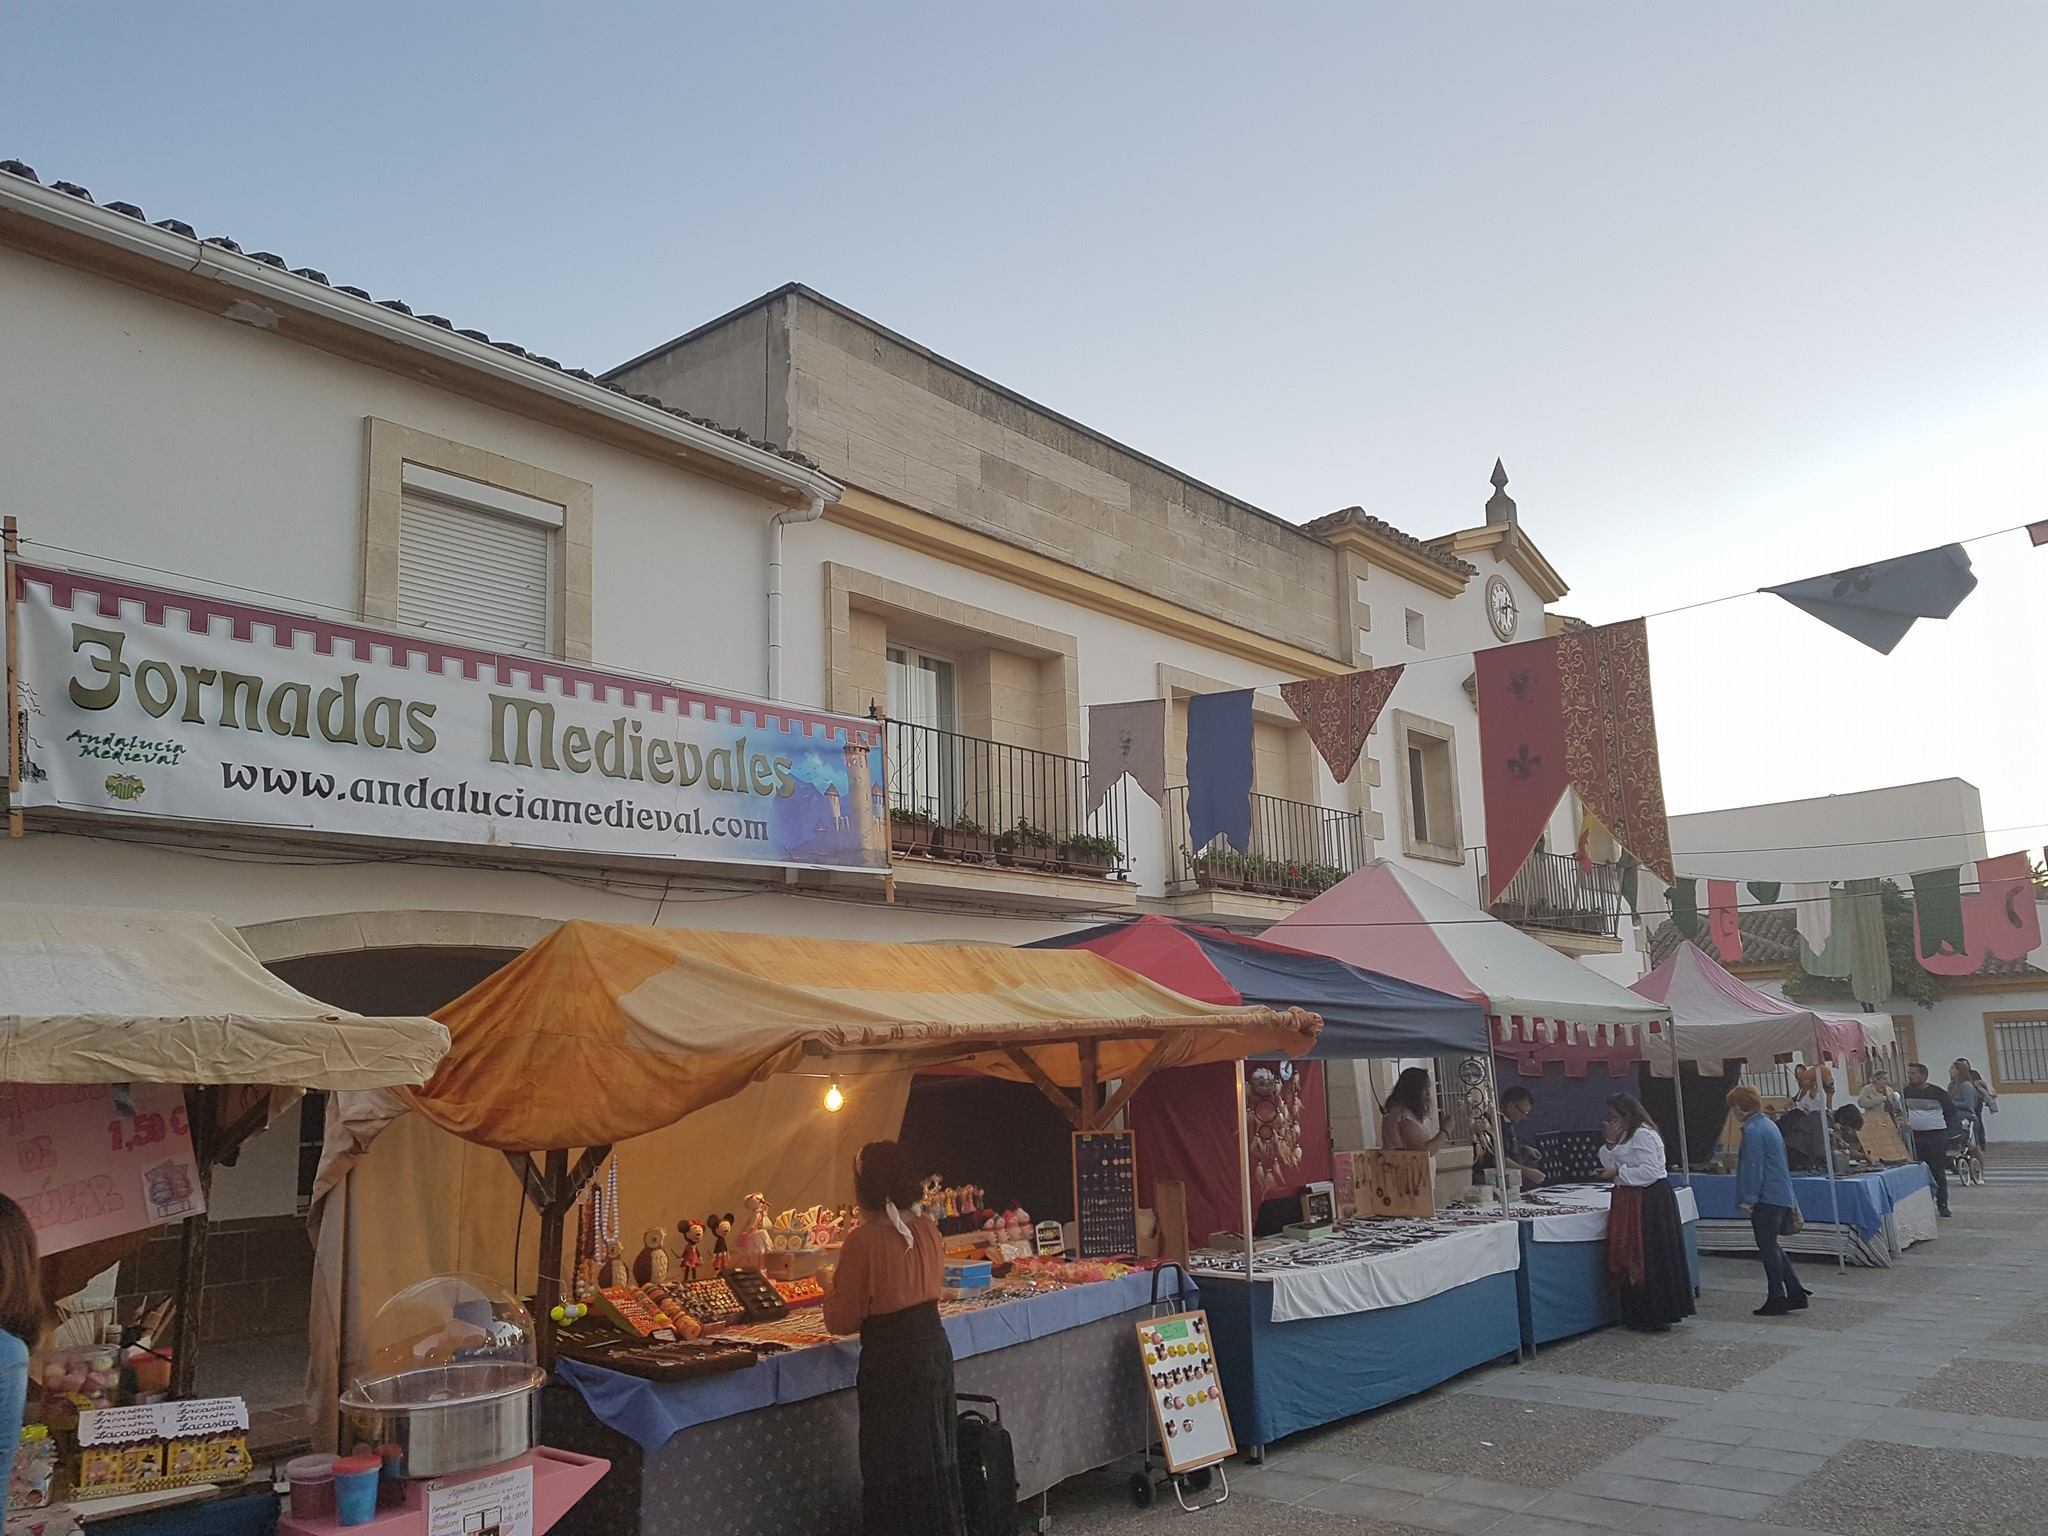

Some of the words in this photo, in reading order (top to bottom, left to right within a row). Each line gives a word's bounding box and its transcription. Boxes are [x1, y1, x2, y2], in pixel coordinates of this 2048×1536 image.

[68, 622, 437, 754] Jornadas
[488, 692, 796, 799] Medievales
[65, 728, 187, 754] Andalucía
[78, 744, 180, 766] Medieval
[220, 761, 770, 841] www.andaluciamedieval.com
[94, 1428, 158, 1440] Lacasitos
[178, 1419, 239, 1432] Lacasitos
